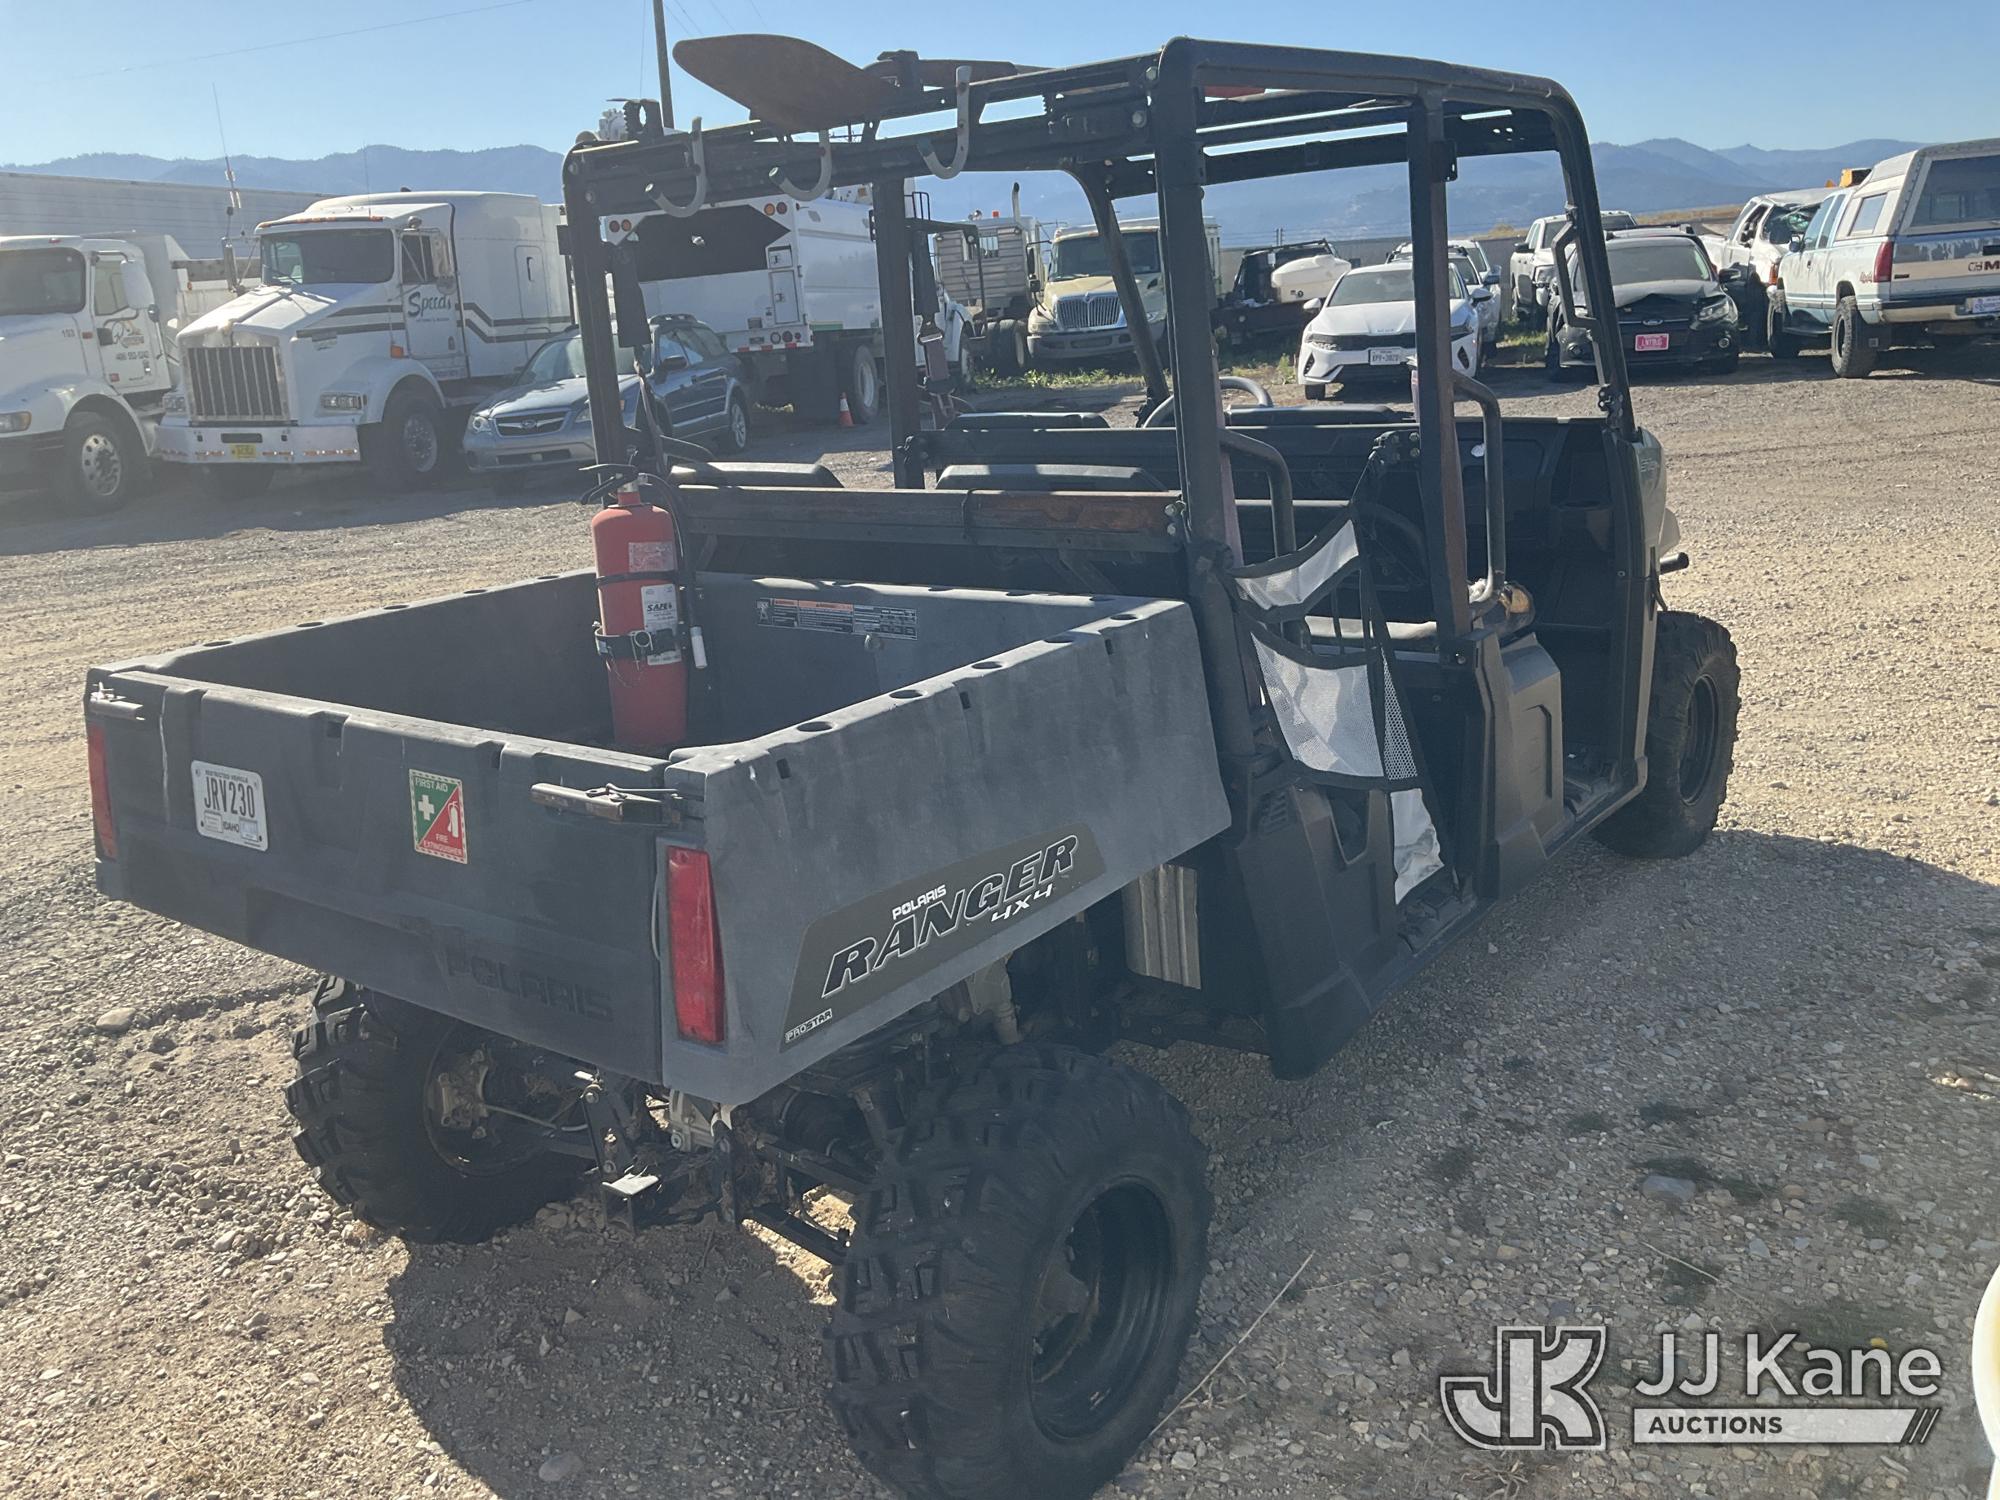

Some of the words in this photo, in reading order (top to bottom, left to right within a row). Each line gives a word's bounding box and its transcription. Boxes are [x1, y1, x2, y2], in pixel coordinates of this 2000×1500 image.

[204, 776, 256, 819] JRV230
[415, 777, 435, 790] FIRST
[435, 782, 449, 793] AID
[821, 834, 1079, 999] RANGER
[891, 884, 947, 921] POLARIS
[784, 1008, 833, 1042] PROSTAR
